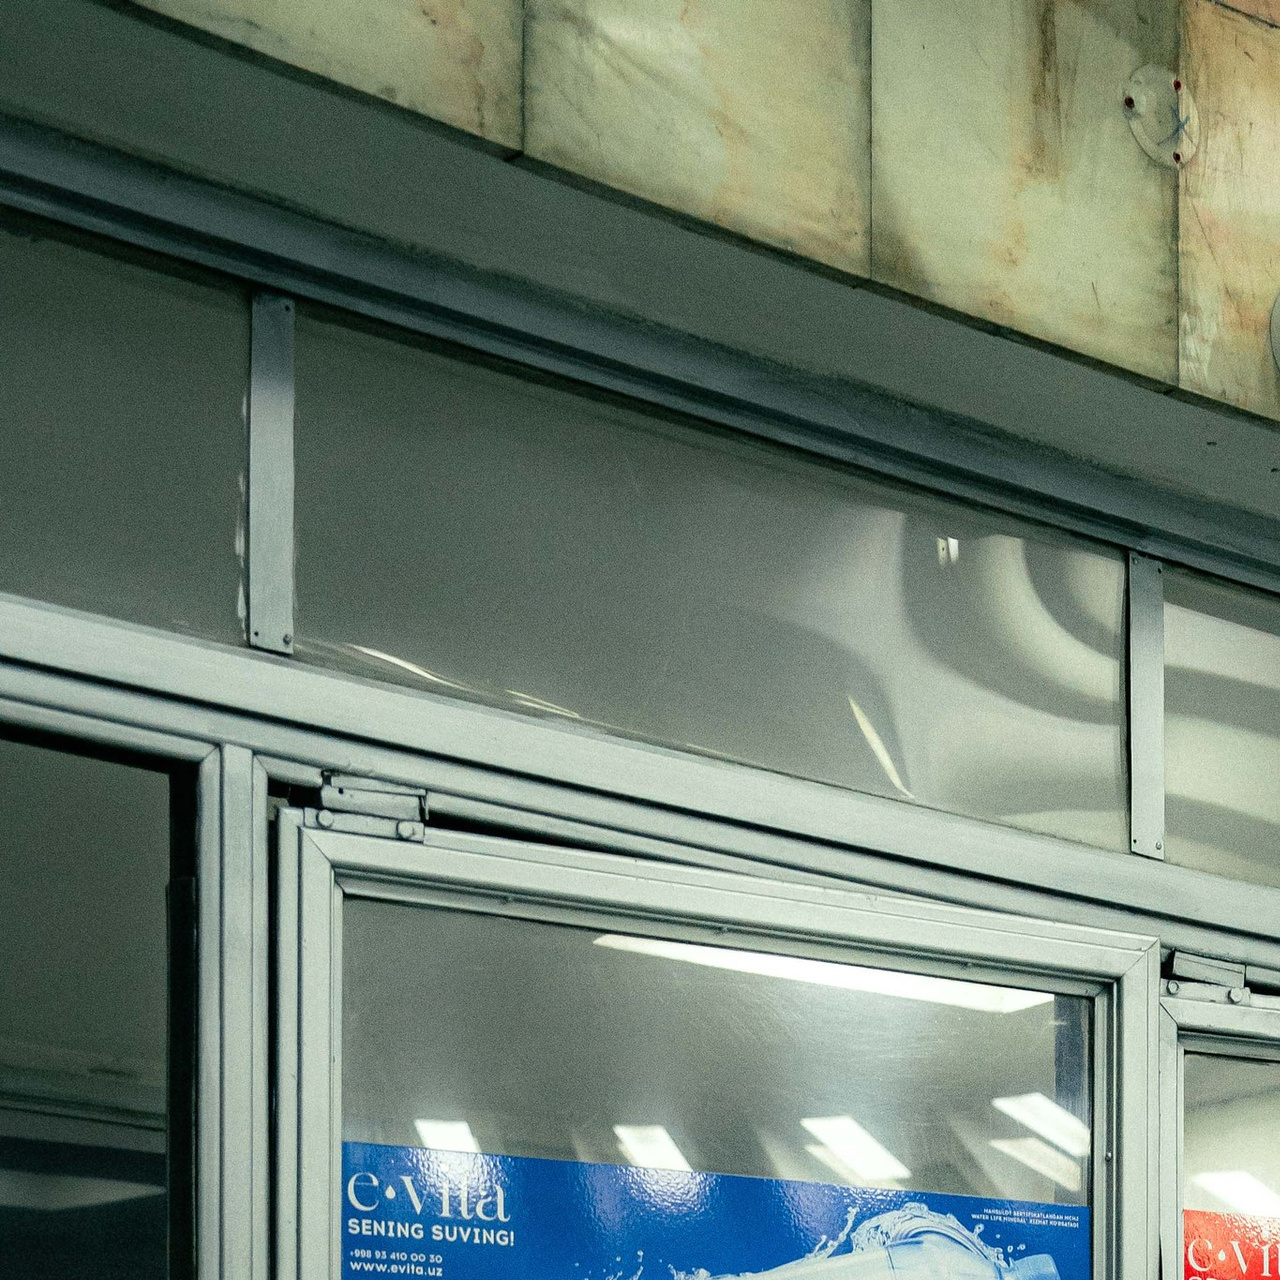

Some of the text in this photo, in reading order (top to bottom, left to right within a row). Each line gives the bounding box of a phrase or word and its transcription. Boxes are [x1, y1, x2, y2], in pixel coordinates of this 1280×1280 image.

[348, 1218, 515, 1247] SENING SUVING!
[350, 1249, 443, 1264] +998 93 410 00 30
[350, 1261, 443, 1277] www.evita.uz
